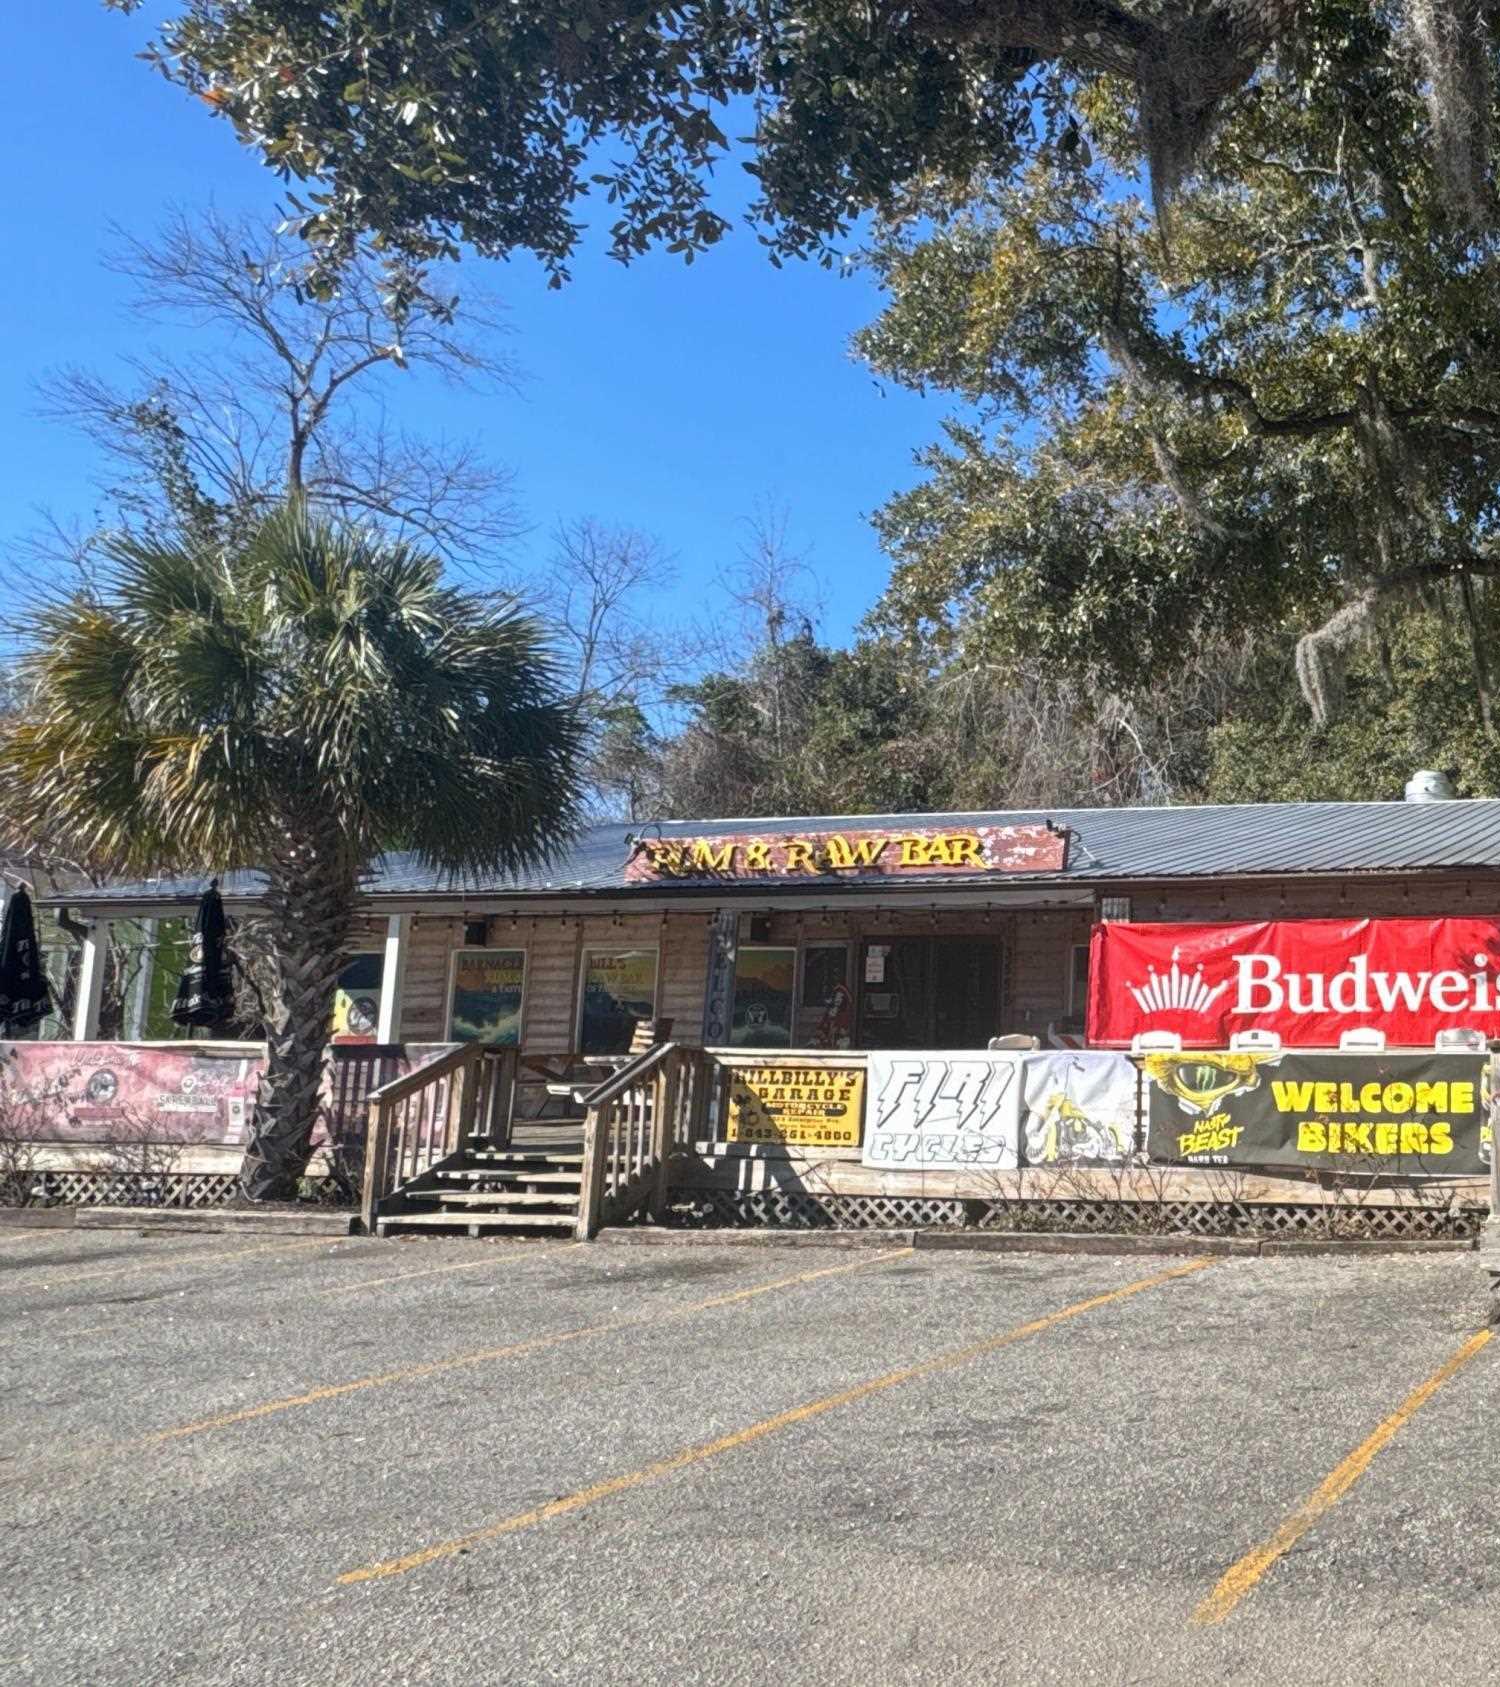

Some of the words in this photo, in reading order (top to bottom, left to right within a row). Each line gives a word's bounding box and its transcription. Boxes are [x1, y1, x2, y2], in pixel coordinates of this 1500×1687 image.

[745, 838, 777, 871] &
[785, 834, 889, 874] RAW
[899, 834, 990, 870] BAR
[760, 1088, 851, 1101] GARAGE
[1271, 1081, 1475, 1114] WELCOME
[870, 1133, 1007, 1163] CYCLES
[1176, 1126, 1245, 1156] BEAST
[1296, 1121, 1454, 1154] BIKERS
